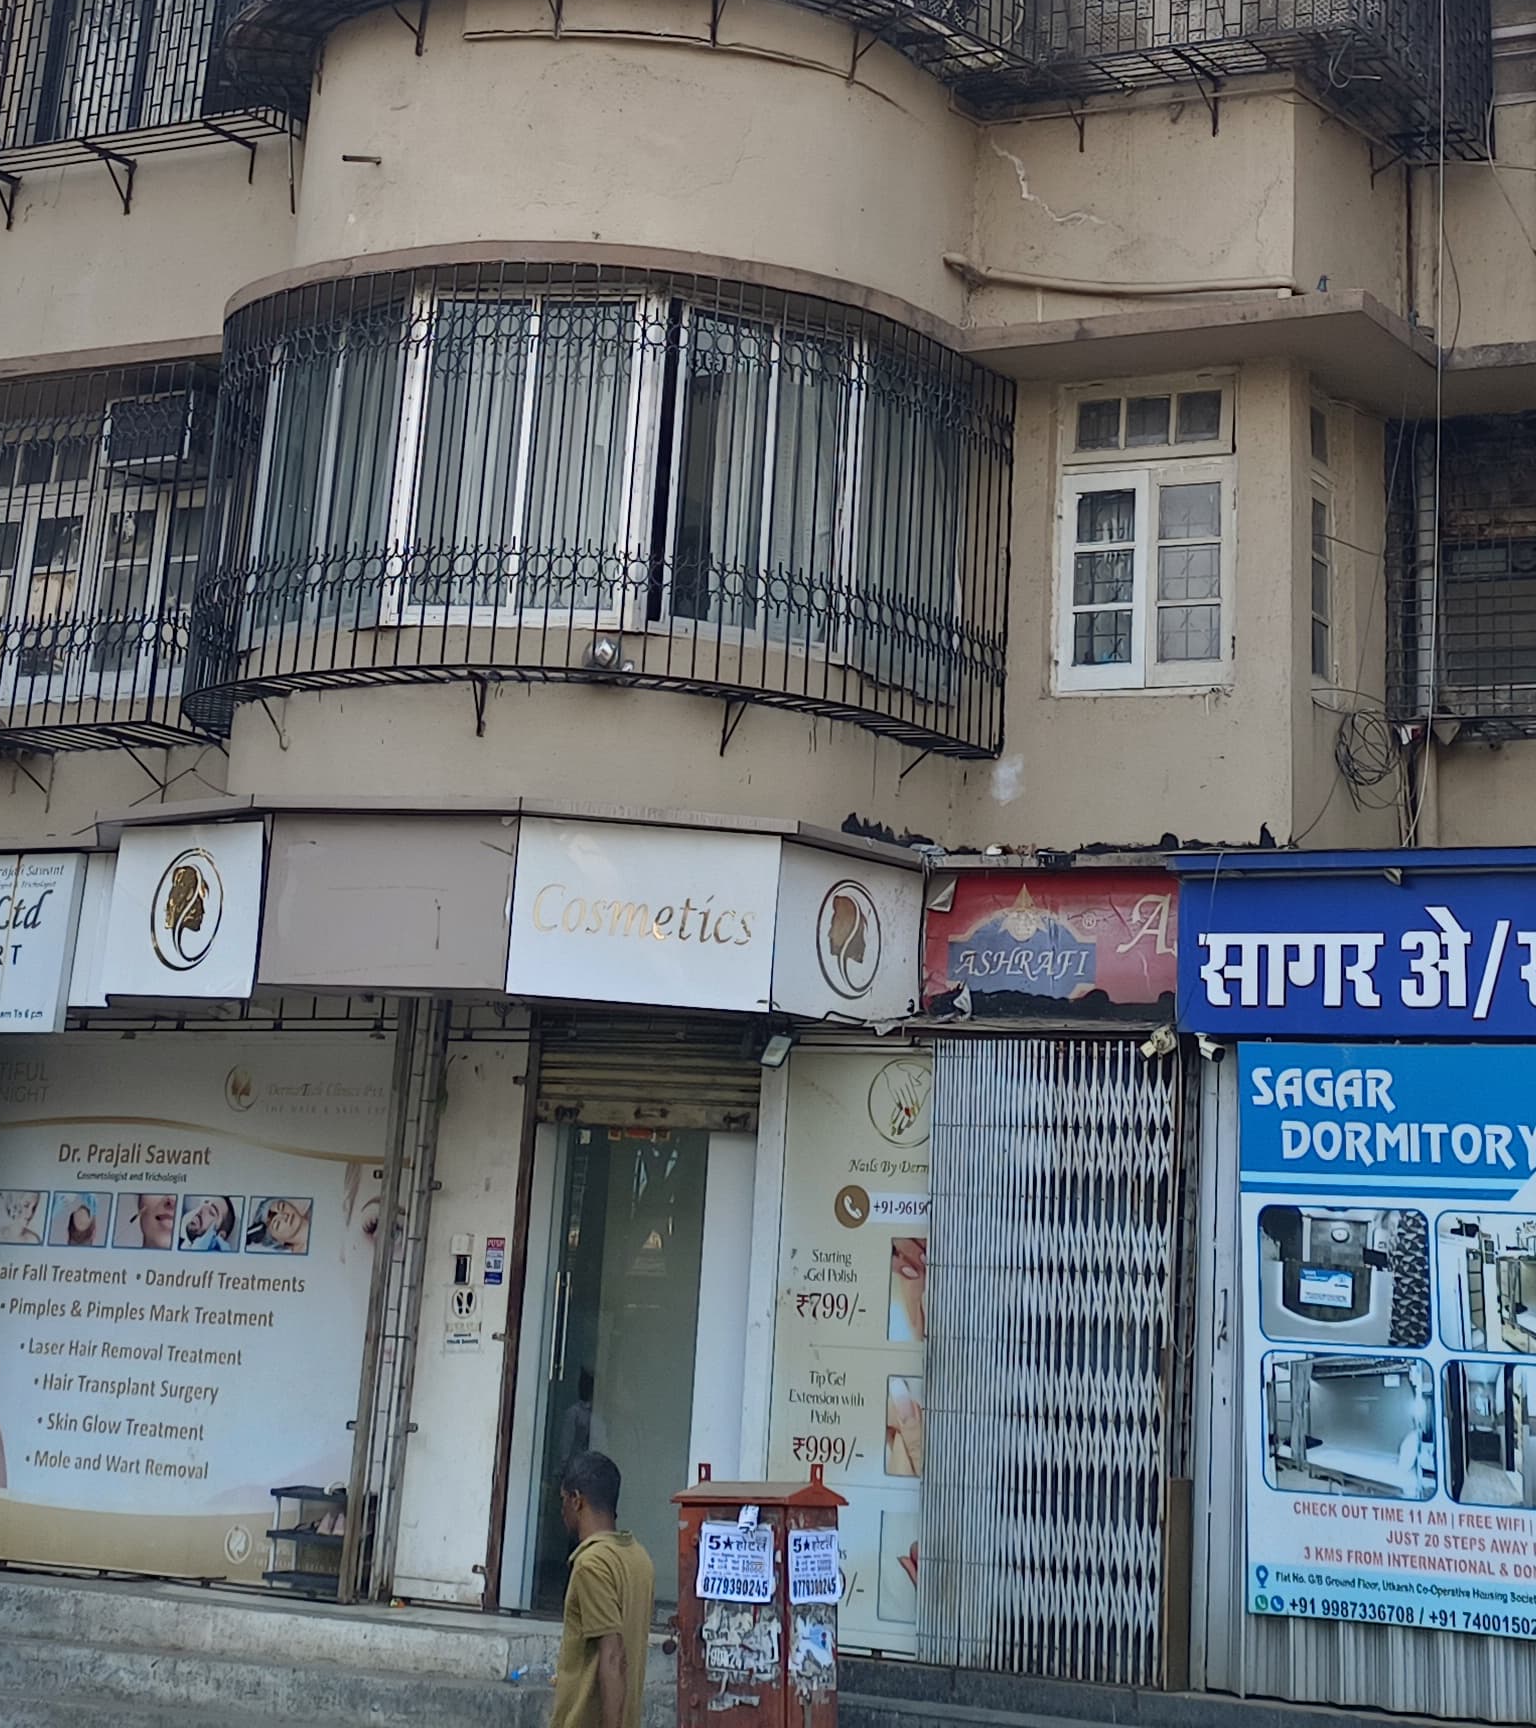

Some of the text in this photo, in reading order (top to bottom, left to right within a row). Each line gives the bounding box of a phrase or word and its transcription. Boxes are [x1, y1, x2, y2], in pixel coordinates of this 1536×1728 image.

[531, 882, 756, 950] Cosmetics
[956, 947, 1090, 982] ASHRAFI
[1198, 930, 1384, 1011] सागर
[1251, 1066, 1396, 1114] SAGAR
[58, 1143, 211, 1168] Dr. Prajali Sawant
[812, 1249, 852, 1266] Starting
[22, 1264, 48, 1282] Fall
[51, 1265, 127, 1285] Treatment
[145, 1270, 306, 1294] Dandruff Treatments
[9, 1297, 274, 1328] Pimples Pimples Mark Treatment
[29, 1337, 242, 1366] Laser Hair Removal Treatment
[42, 1373, 219, 1405] Hair Transplant Surgery
[789, 1388, 840, 1405] Extension
[47, 1412, 205, 1441] Skin Glow Treatment
[34, 1450, 209, 1479] Mole and Wart Removal
[1293, 1501, 1338, 1518] CHECK
[1341, 1504, 1368, 1520] OUT
[1372, 1507, 1405, 1523] TIME
[1427, 1510, 1447, 1526] AM
[1459, 1513, 1493, 1529] FREE
[1496, 1516, 1525, 1533] WIFI
[1386, 1530, 1419, 1546] JUST
[1424, 1534, 1439, 1548] 20
[1444, 1535, 1486, 1552] STEPS
[1490, 1539, 1528, 1557] AWAY
[1315, 1547, 1343, 1563] KMS
[1347, 1550, 1383, 1566] FROM
[1387, 1552, 1495, 1576] INTERNATIONAL
[1289, 1597, 1316, 1615] +91
[1321, 1598, 1415, 1624] 9987336708
[1428, 1609, 1457, 1629] +91
